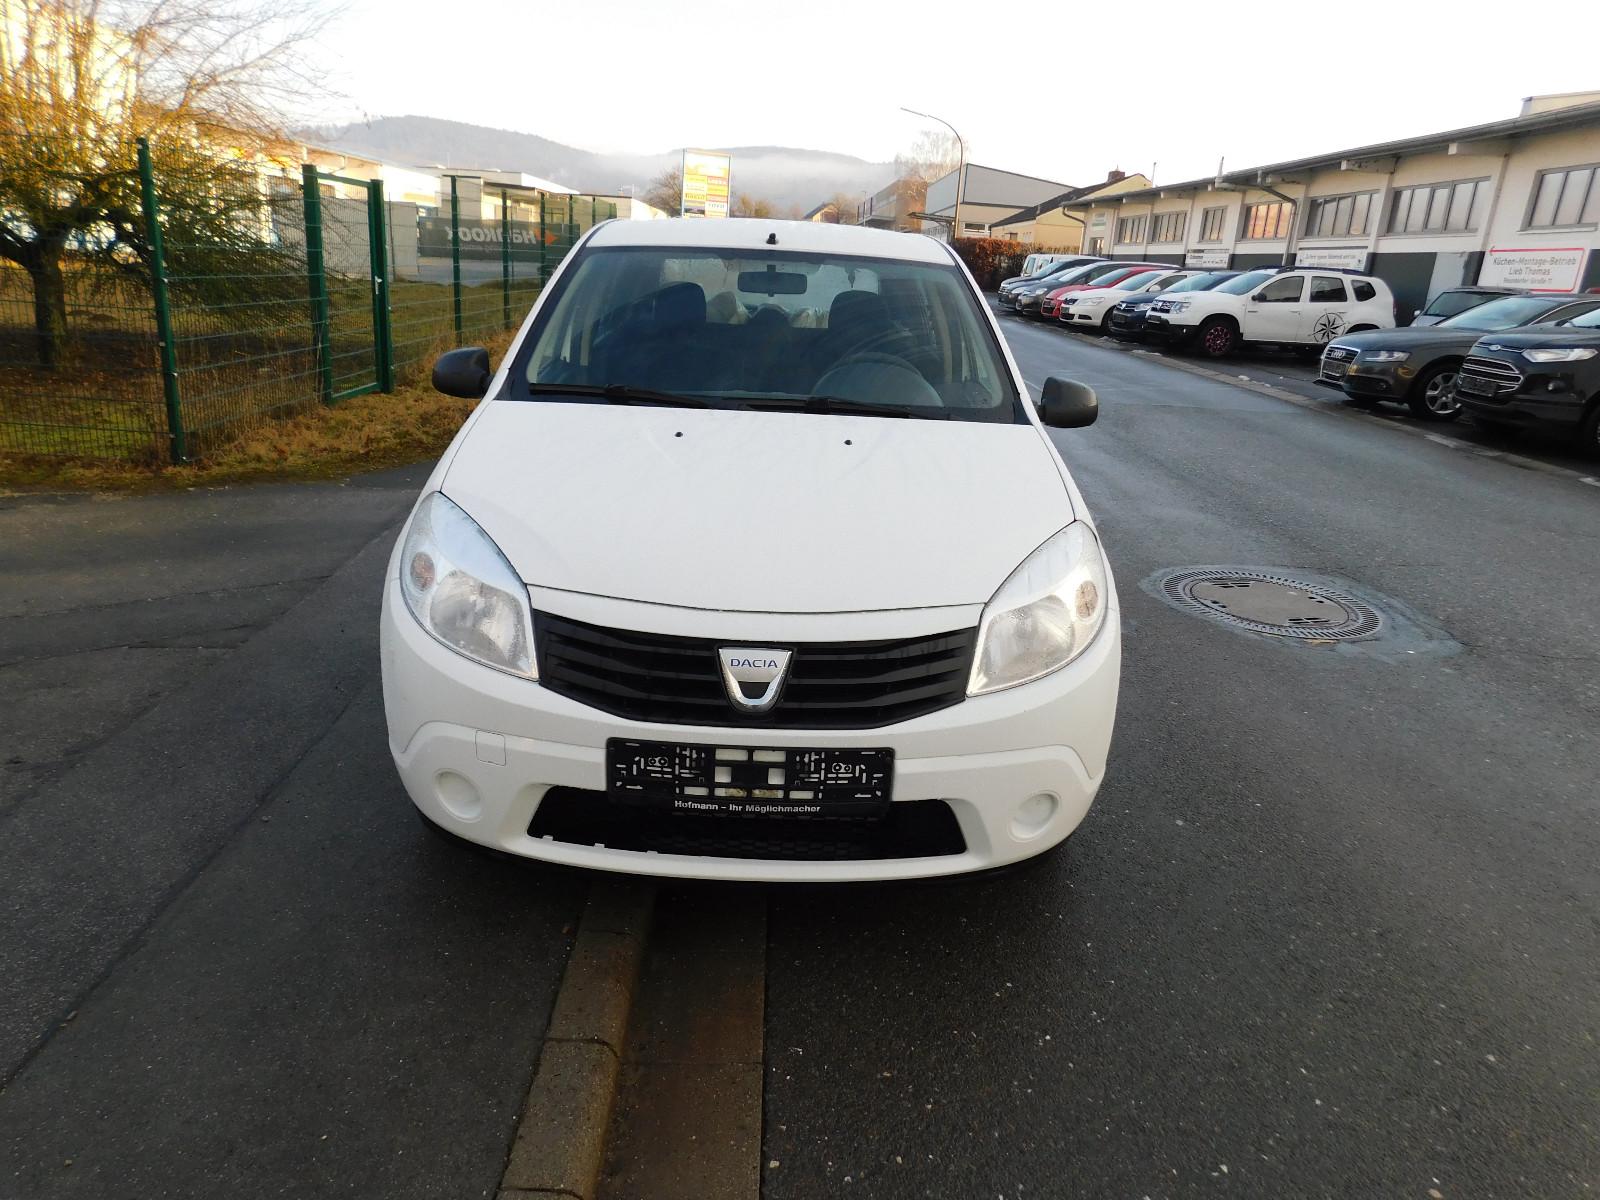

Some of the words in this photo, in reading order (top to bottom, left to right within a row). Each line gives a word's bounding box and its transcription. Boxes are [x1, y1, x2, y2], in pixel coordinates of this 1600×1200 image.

[730, 658, 778, 668] DACIA
[674, 800, 719, 811] Hofmann
[729, 803, 743, 812] Ihr
[745, 804, 821, 814] Möglichmacher
